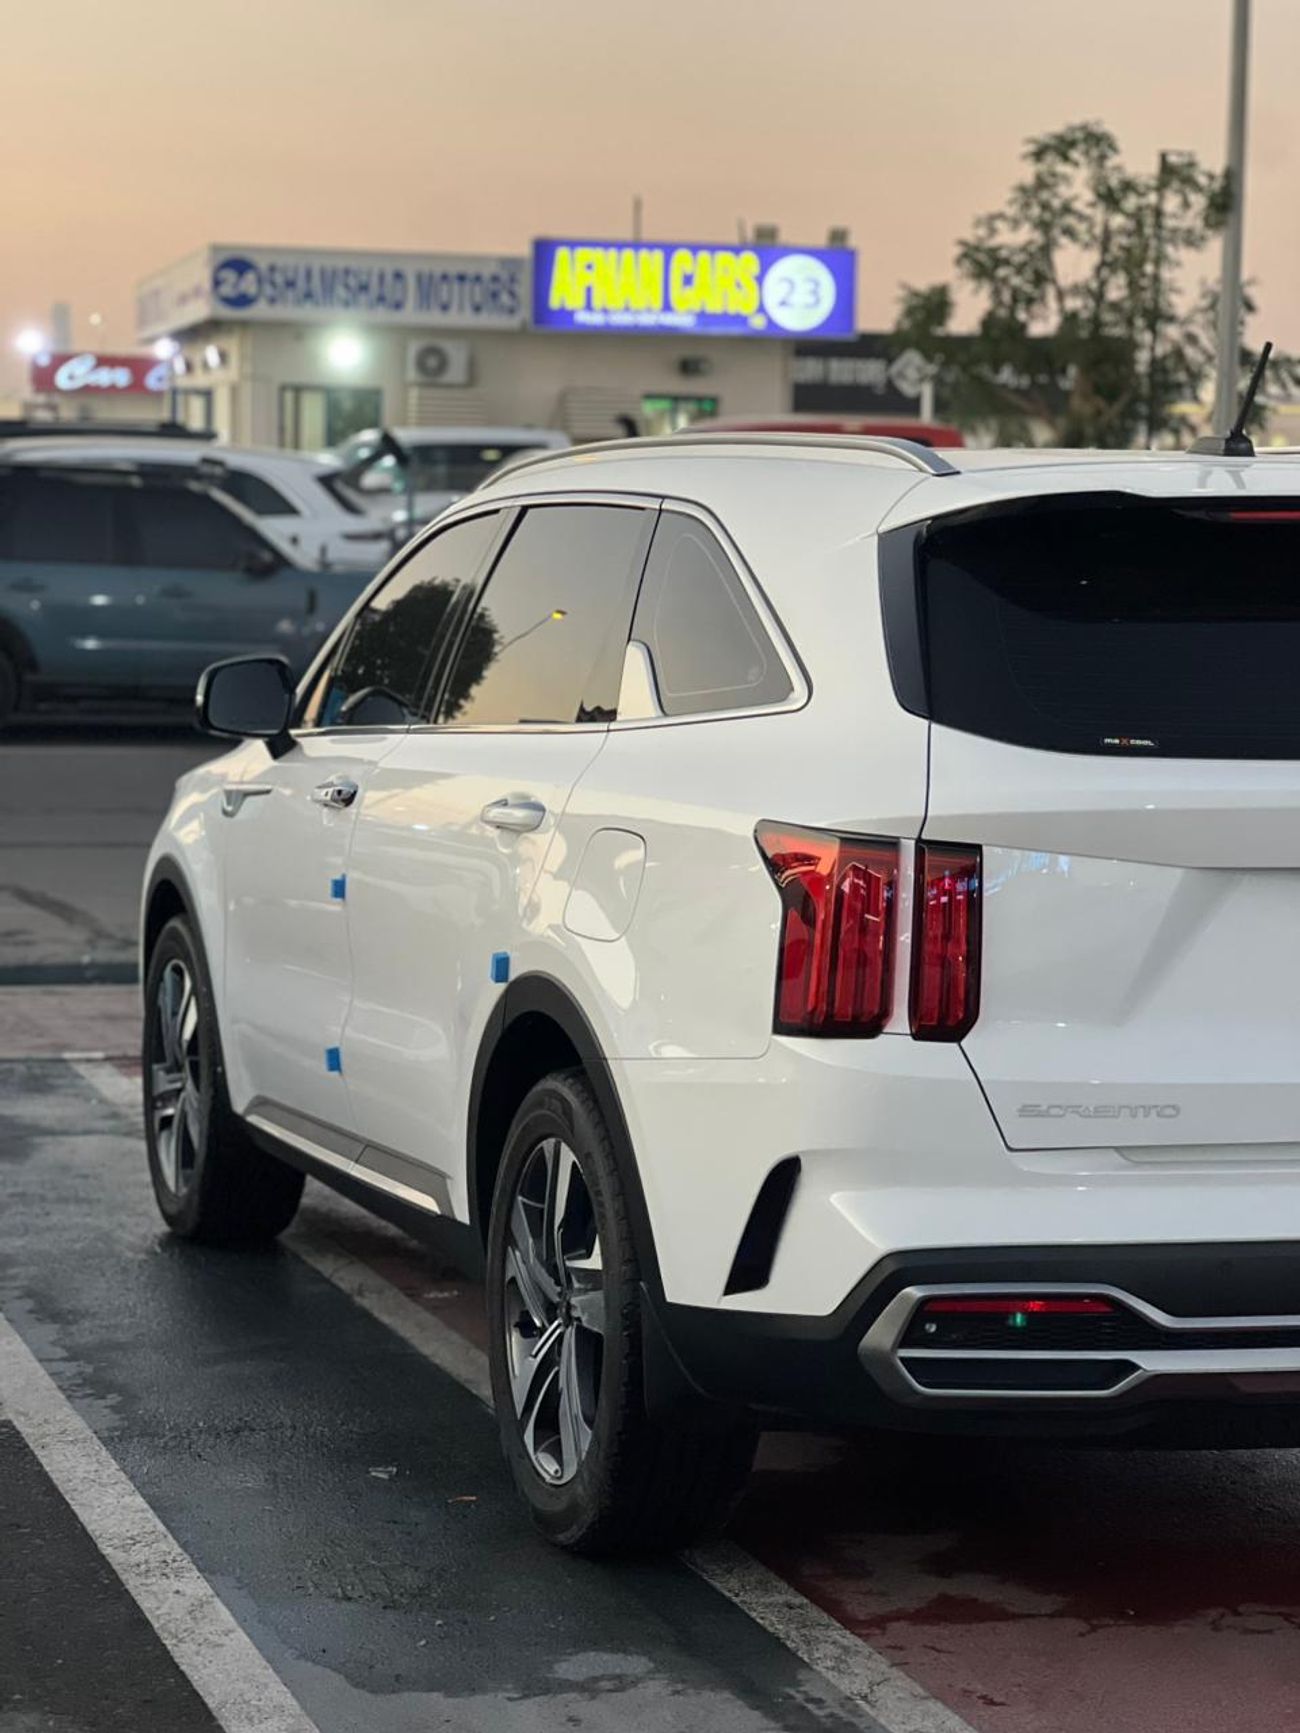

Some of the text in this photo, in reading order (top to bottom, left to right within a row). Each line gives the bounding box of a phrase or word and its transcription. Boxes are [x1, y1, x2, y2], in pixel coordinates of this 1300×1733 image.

[215, 267, 258, 298] 24
[263, 263, 406, 312] SHAMSHAD
[413, 269, 523, 317] MOTORS
[548, 246, 823, 315] AFNAN CARS 23
